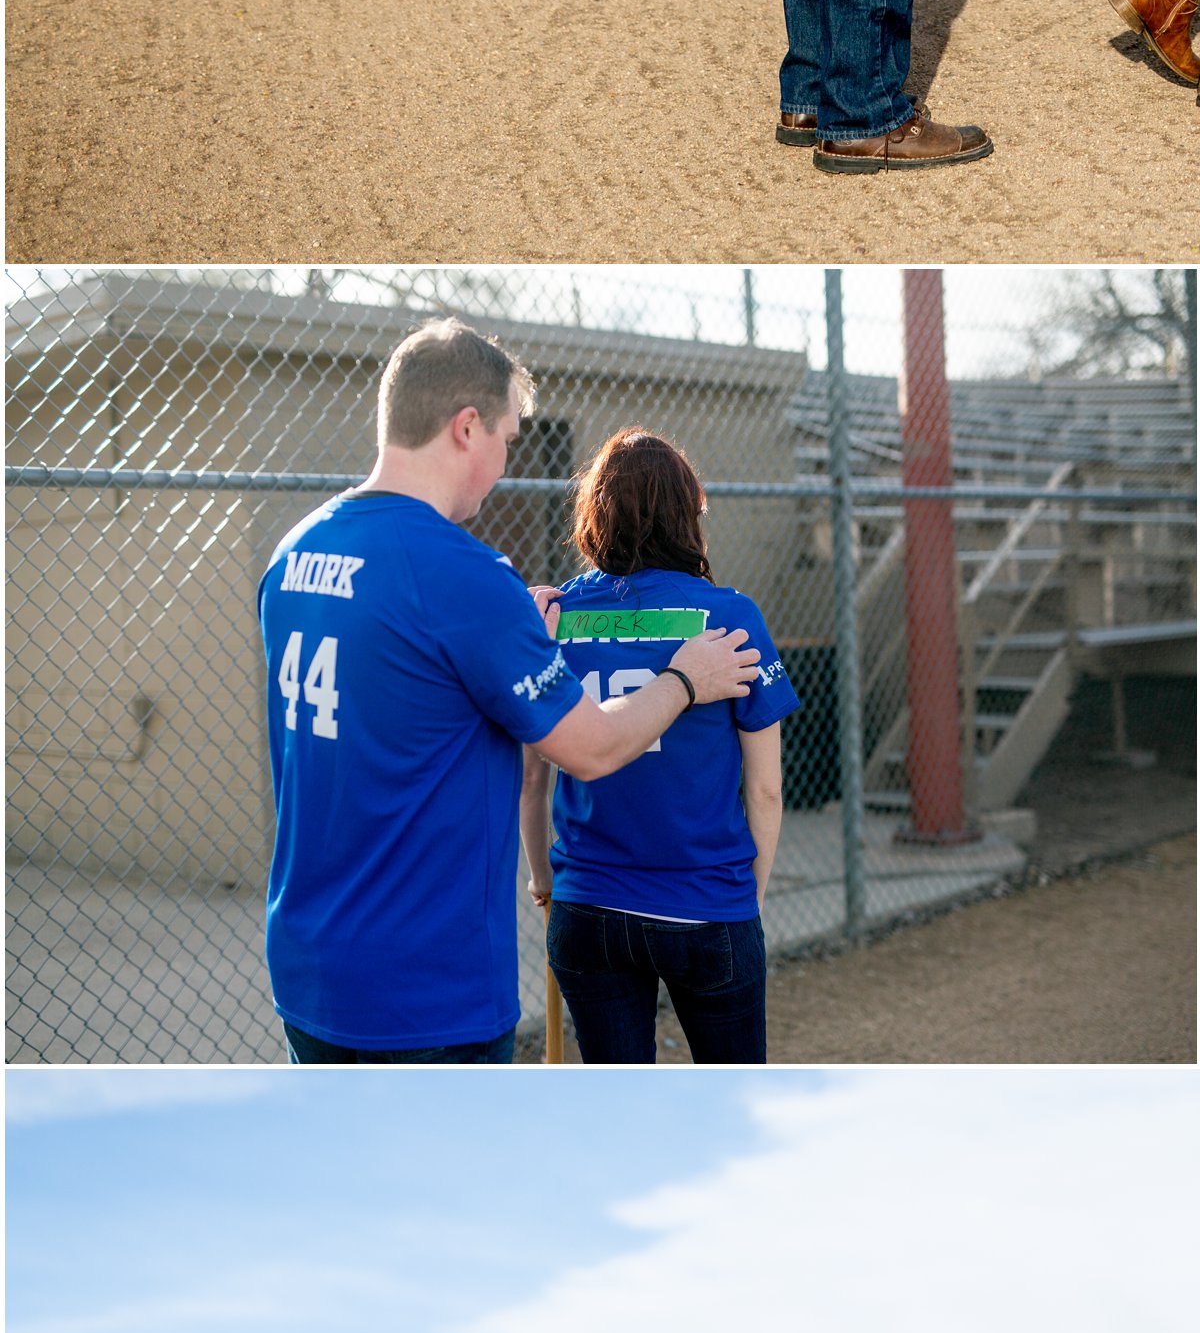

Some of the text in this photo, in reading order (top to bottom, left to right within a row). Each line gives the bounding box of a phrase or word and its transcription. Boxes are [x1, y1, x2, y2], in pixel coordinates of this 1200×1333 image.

[280, 551, 365, 600] MORK
[571, 614, 648, 634] MORK
[278, 631, 339, 740] 44
